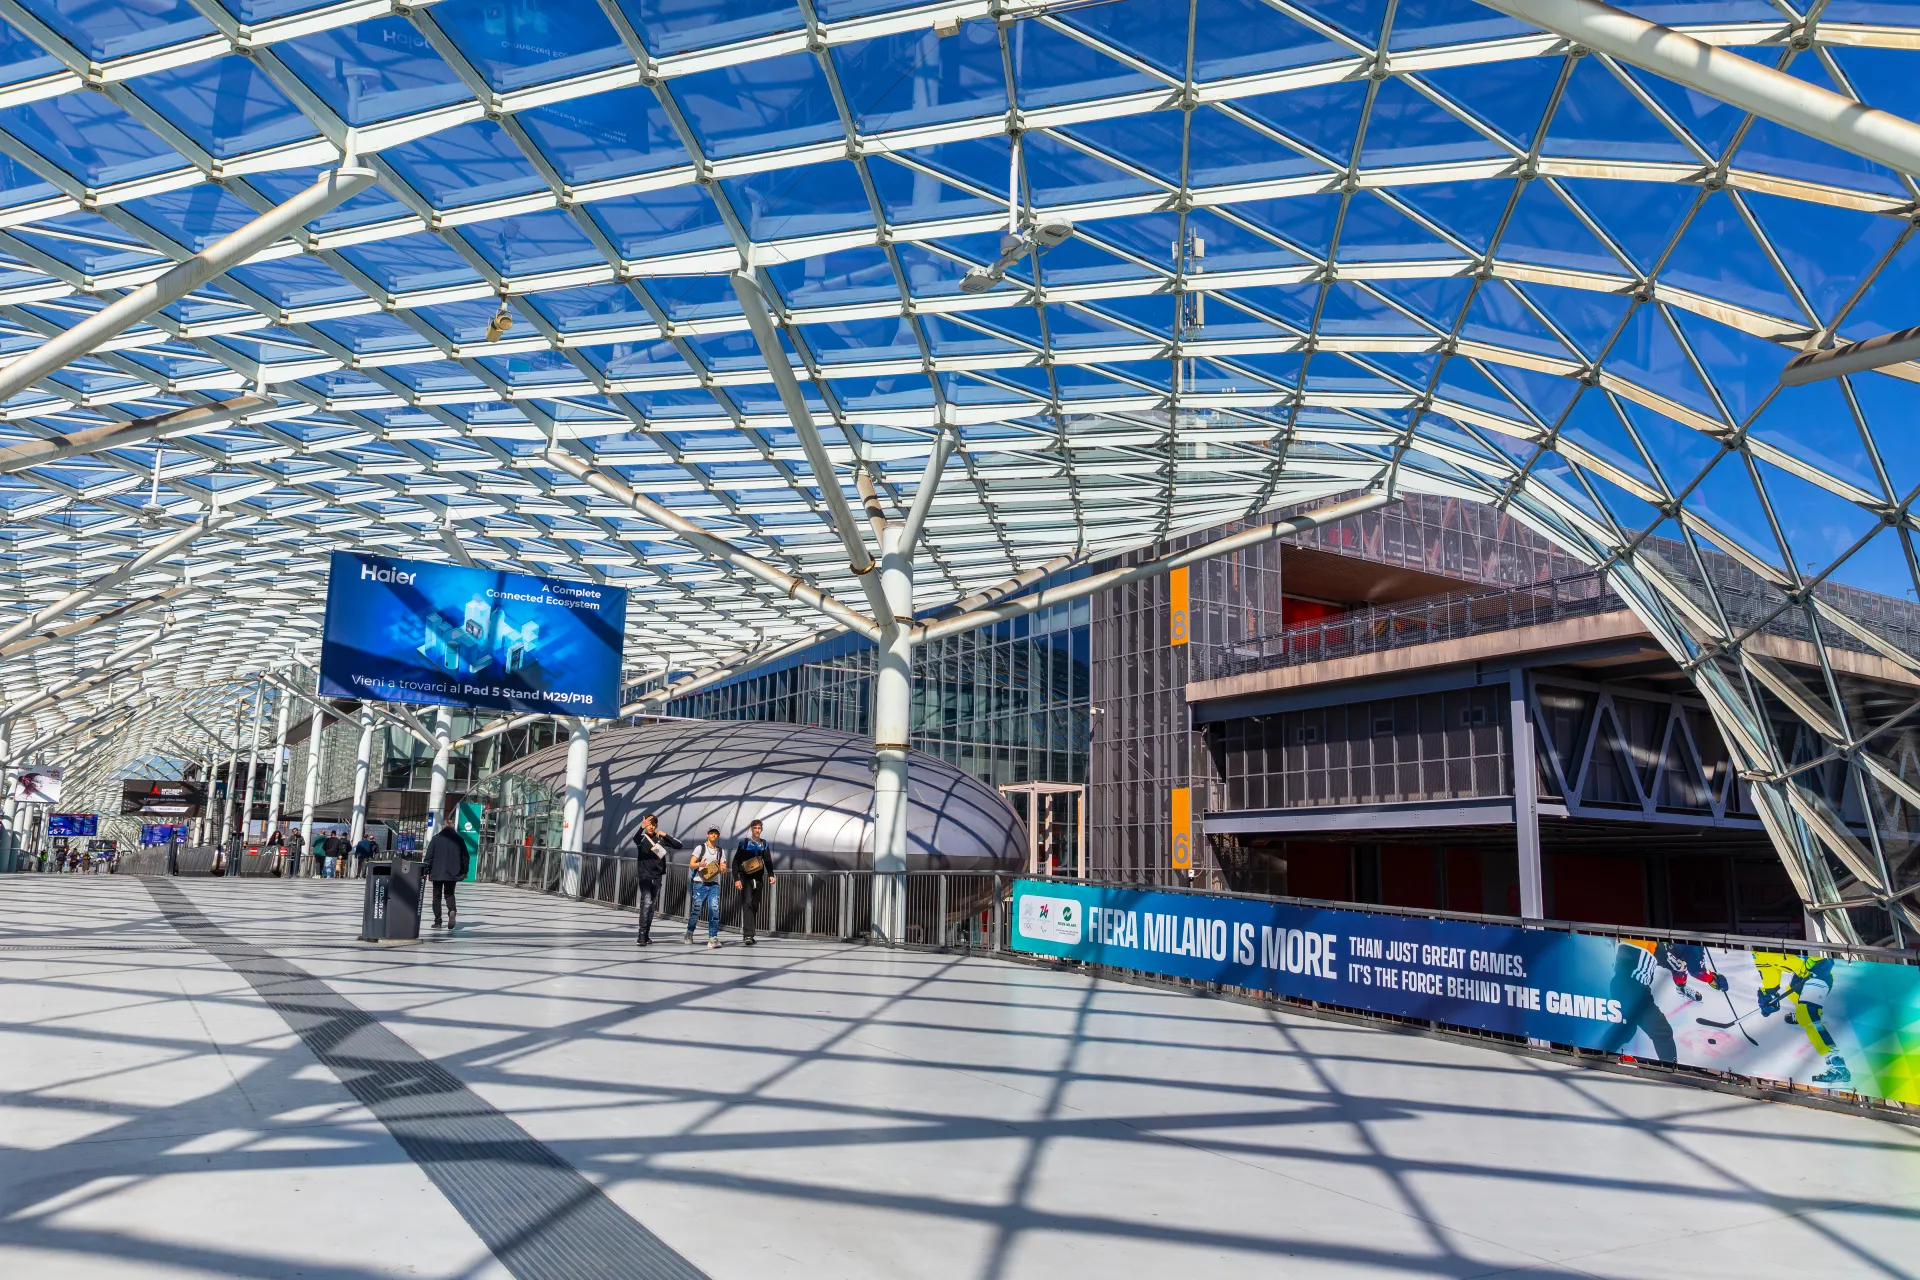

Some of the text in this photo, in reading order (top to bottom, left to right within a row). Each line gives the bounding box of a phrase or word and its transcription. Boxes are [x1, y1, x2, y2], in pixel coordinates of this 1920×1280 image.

[360, 563, 417, 586] Haier
[486, 588, 601, 611] Connected Ecosystem
[542, 584, 602, 599] A Complete
[1172, 610, 1187, 640] 8
[351, 674, 593, 705] Vieni a trovarci al Pad 5 Stand M29/P18
[1173, 833, 1189, 864] 6
[1088, 906, 1337, 980] FIERA MILANO IS MORE
[1348, 936, 1527, 978] THAN JUST GREAT GAMES.
[1348, 963, 1627, 1024] IT'S THE FORCE BEHIND THE GAMES.
